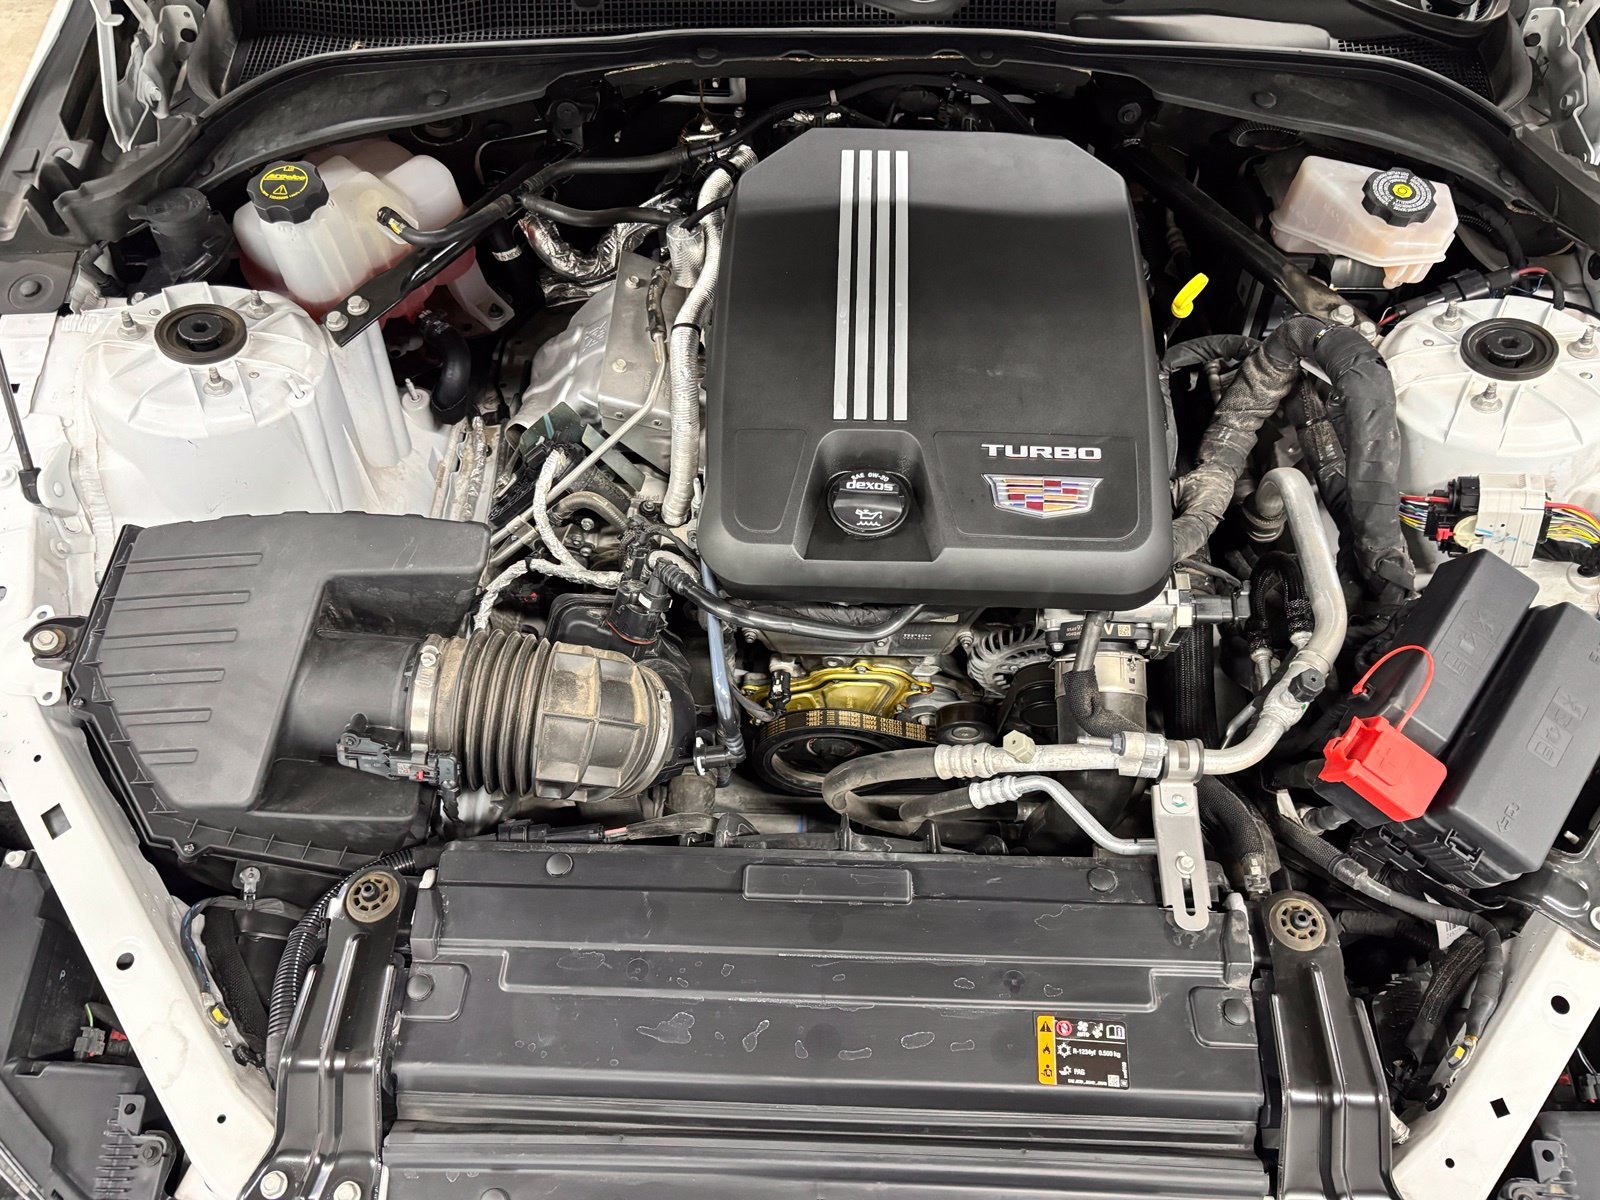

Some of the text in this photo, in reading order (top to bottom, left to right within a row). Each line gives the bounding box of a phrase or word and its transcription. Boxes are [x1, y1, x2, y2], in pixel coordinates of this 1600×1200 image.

[981, 444, 1102, 459] TURBO
[851, 472, 889, 482] SAE 0W-20
[846, 479, 894, 491] dexos
[1074, 1068, 1086, 1076] PAG
